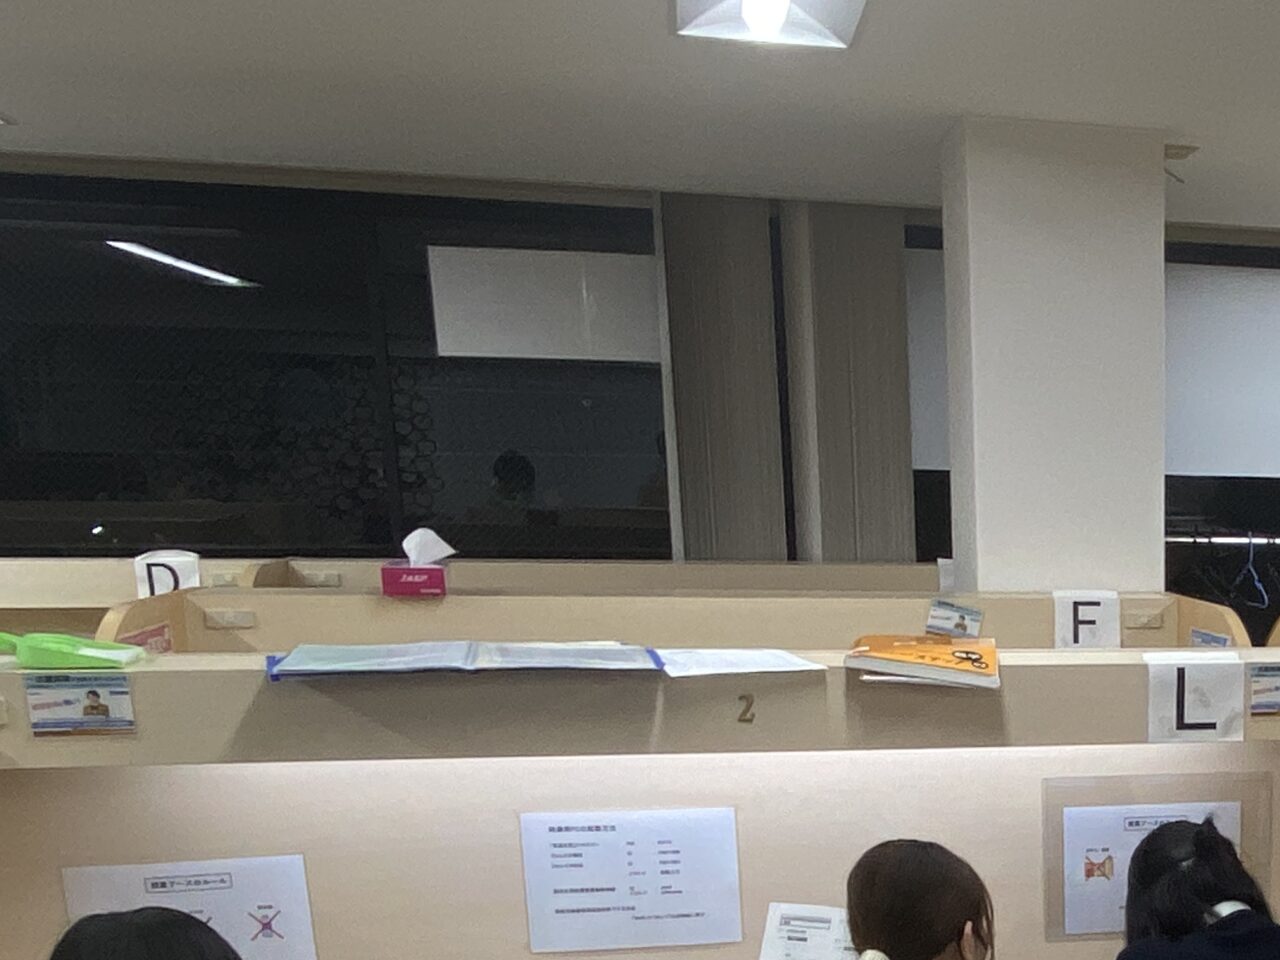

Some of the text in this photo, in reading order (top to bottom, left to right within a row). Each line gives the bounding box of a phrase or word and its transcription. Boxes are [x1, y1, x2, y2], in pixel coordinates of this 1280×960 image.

[146, 563, 180, 597] D
[1073, 601, 1101, 644] F
[738, 694, 755, 724] 2
[1176, 667, 1217, 730] L
